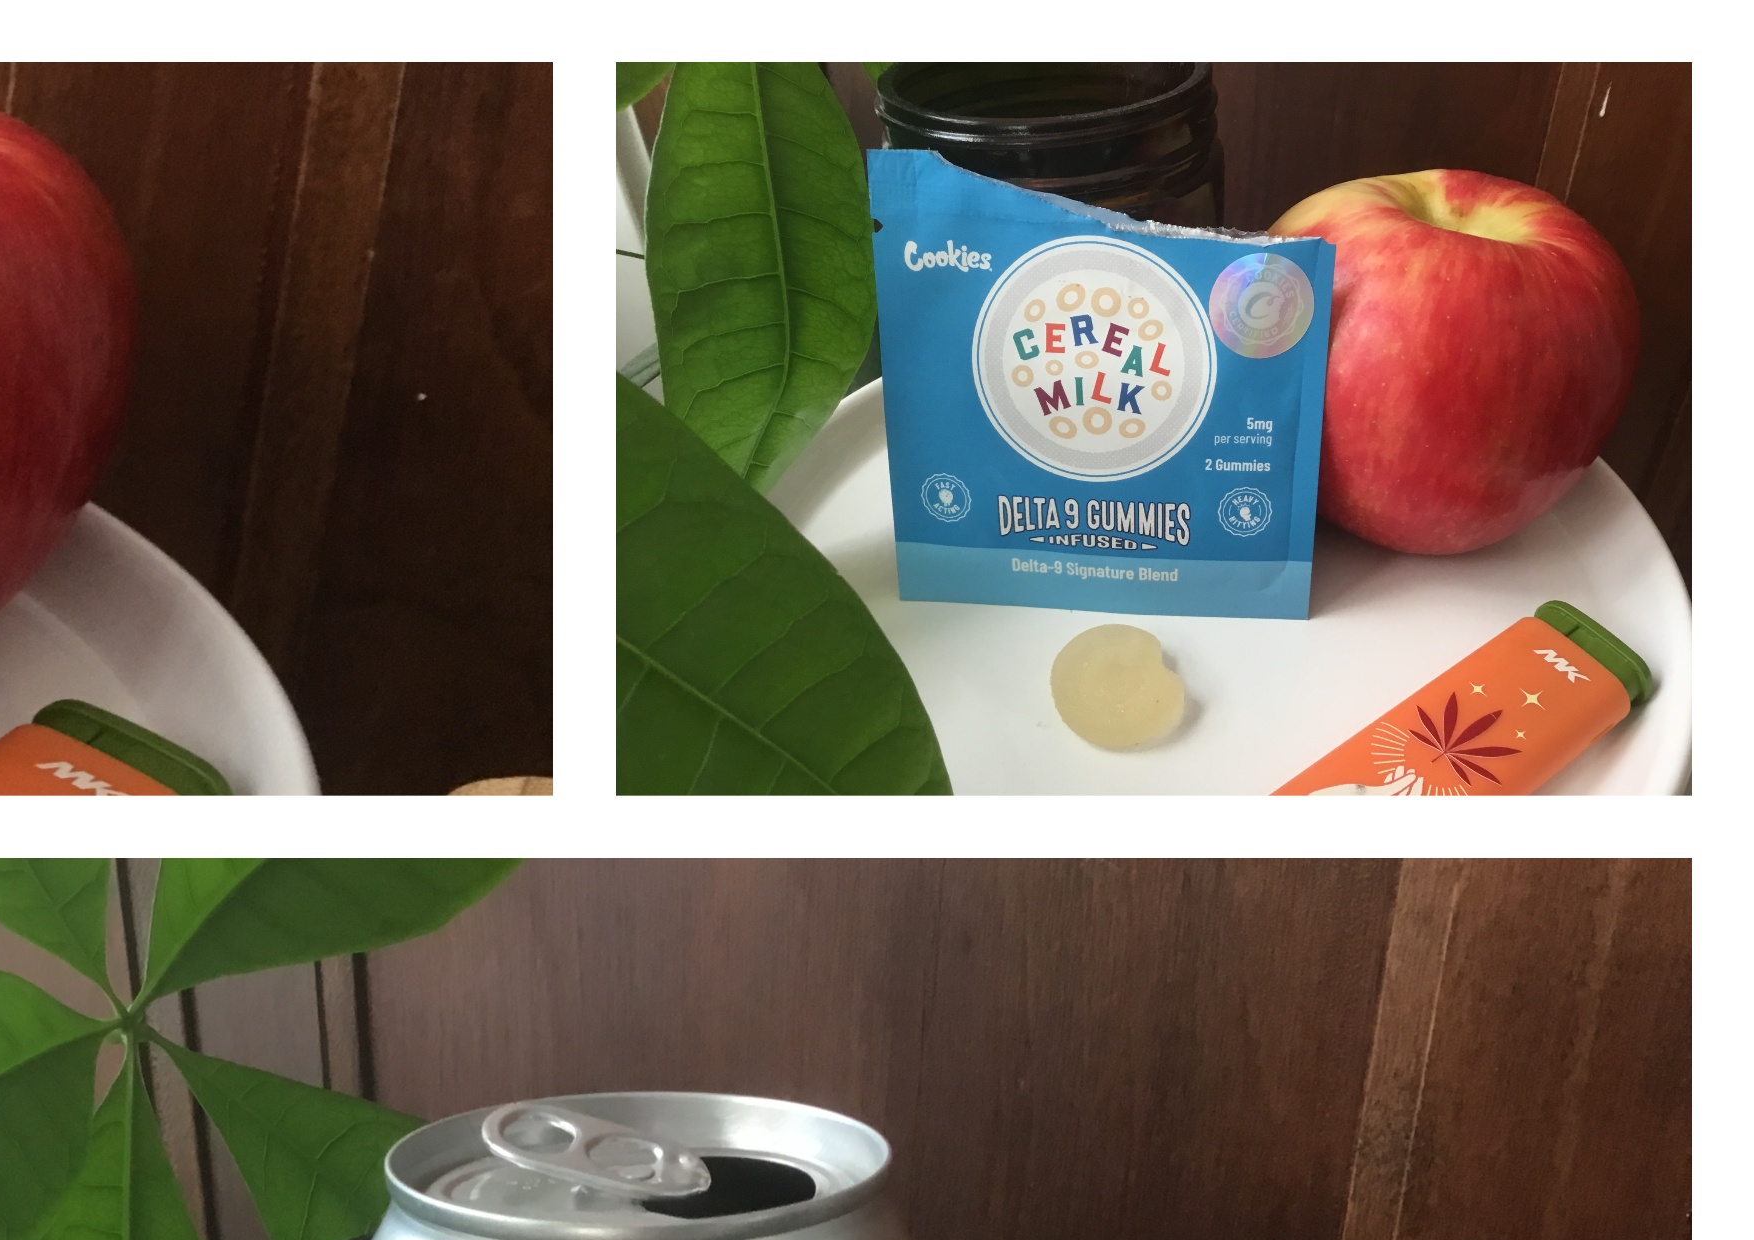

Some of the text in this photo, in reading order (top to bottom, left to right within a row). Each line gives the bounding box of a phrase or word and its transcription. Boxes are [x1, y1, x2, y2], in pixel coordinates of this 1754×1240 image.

[903, 239, 993, 273] Cookies
[1013, 314, 1172, 377] CEREAL
[1034, 372, 1145, 416] MILK
[1246, 417, 1273, 433] 5mg
[1214, 433, 1273, 447] per serving
[1205, 458, 1271, 472] 2 Gummies
[935, 481, 956, 490] FAST
[1231, 495, 1260, 506] HEAVY
[997, 494, 1191, 546] DELTA 9 GUMMIES
[1228, 515, 1261, 529] HITTING
[1048, 533, 1138, 550] INFUSED
[1011, 557, 1179, 582] Delta-9 Signature Blend
